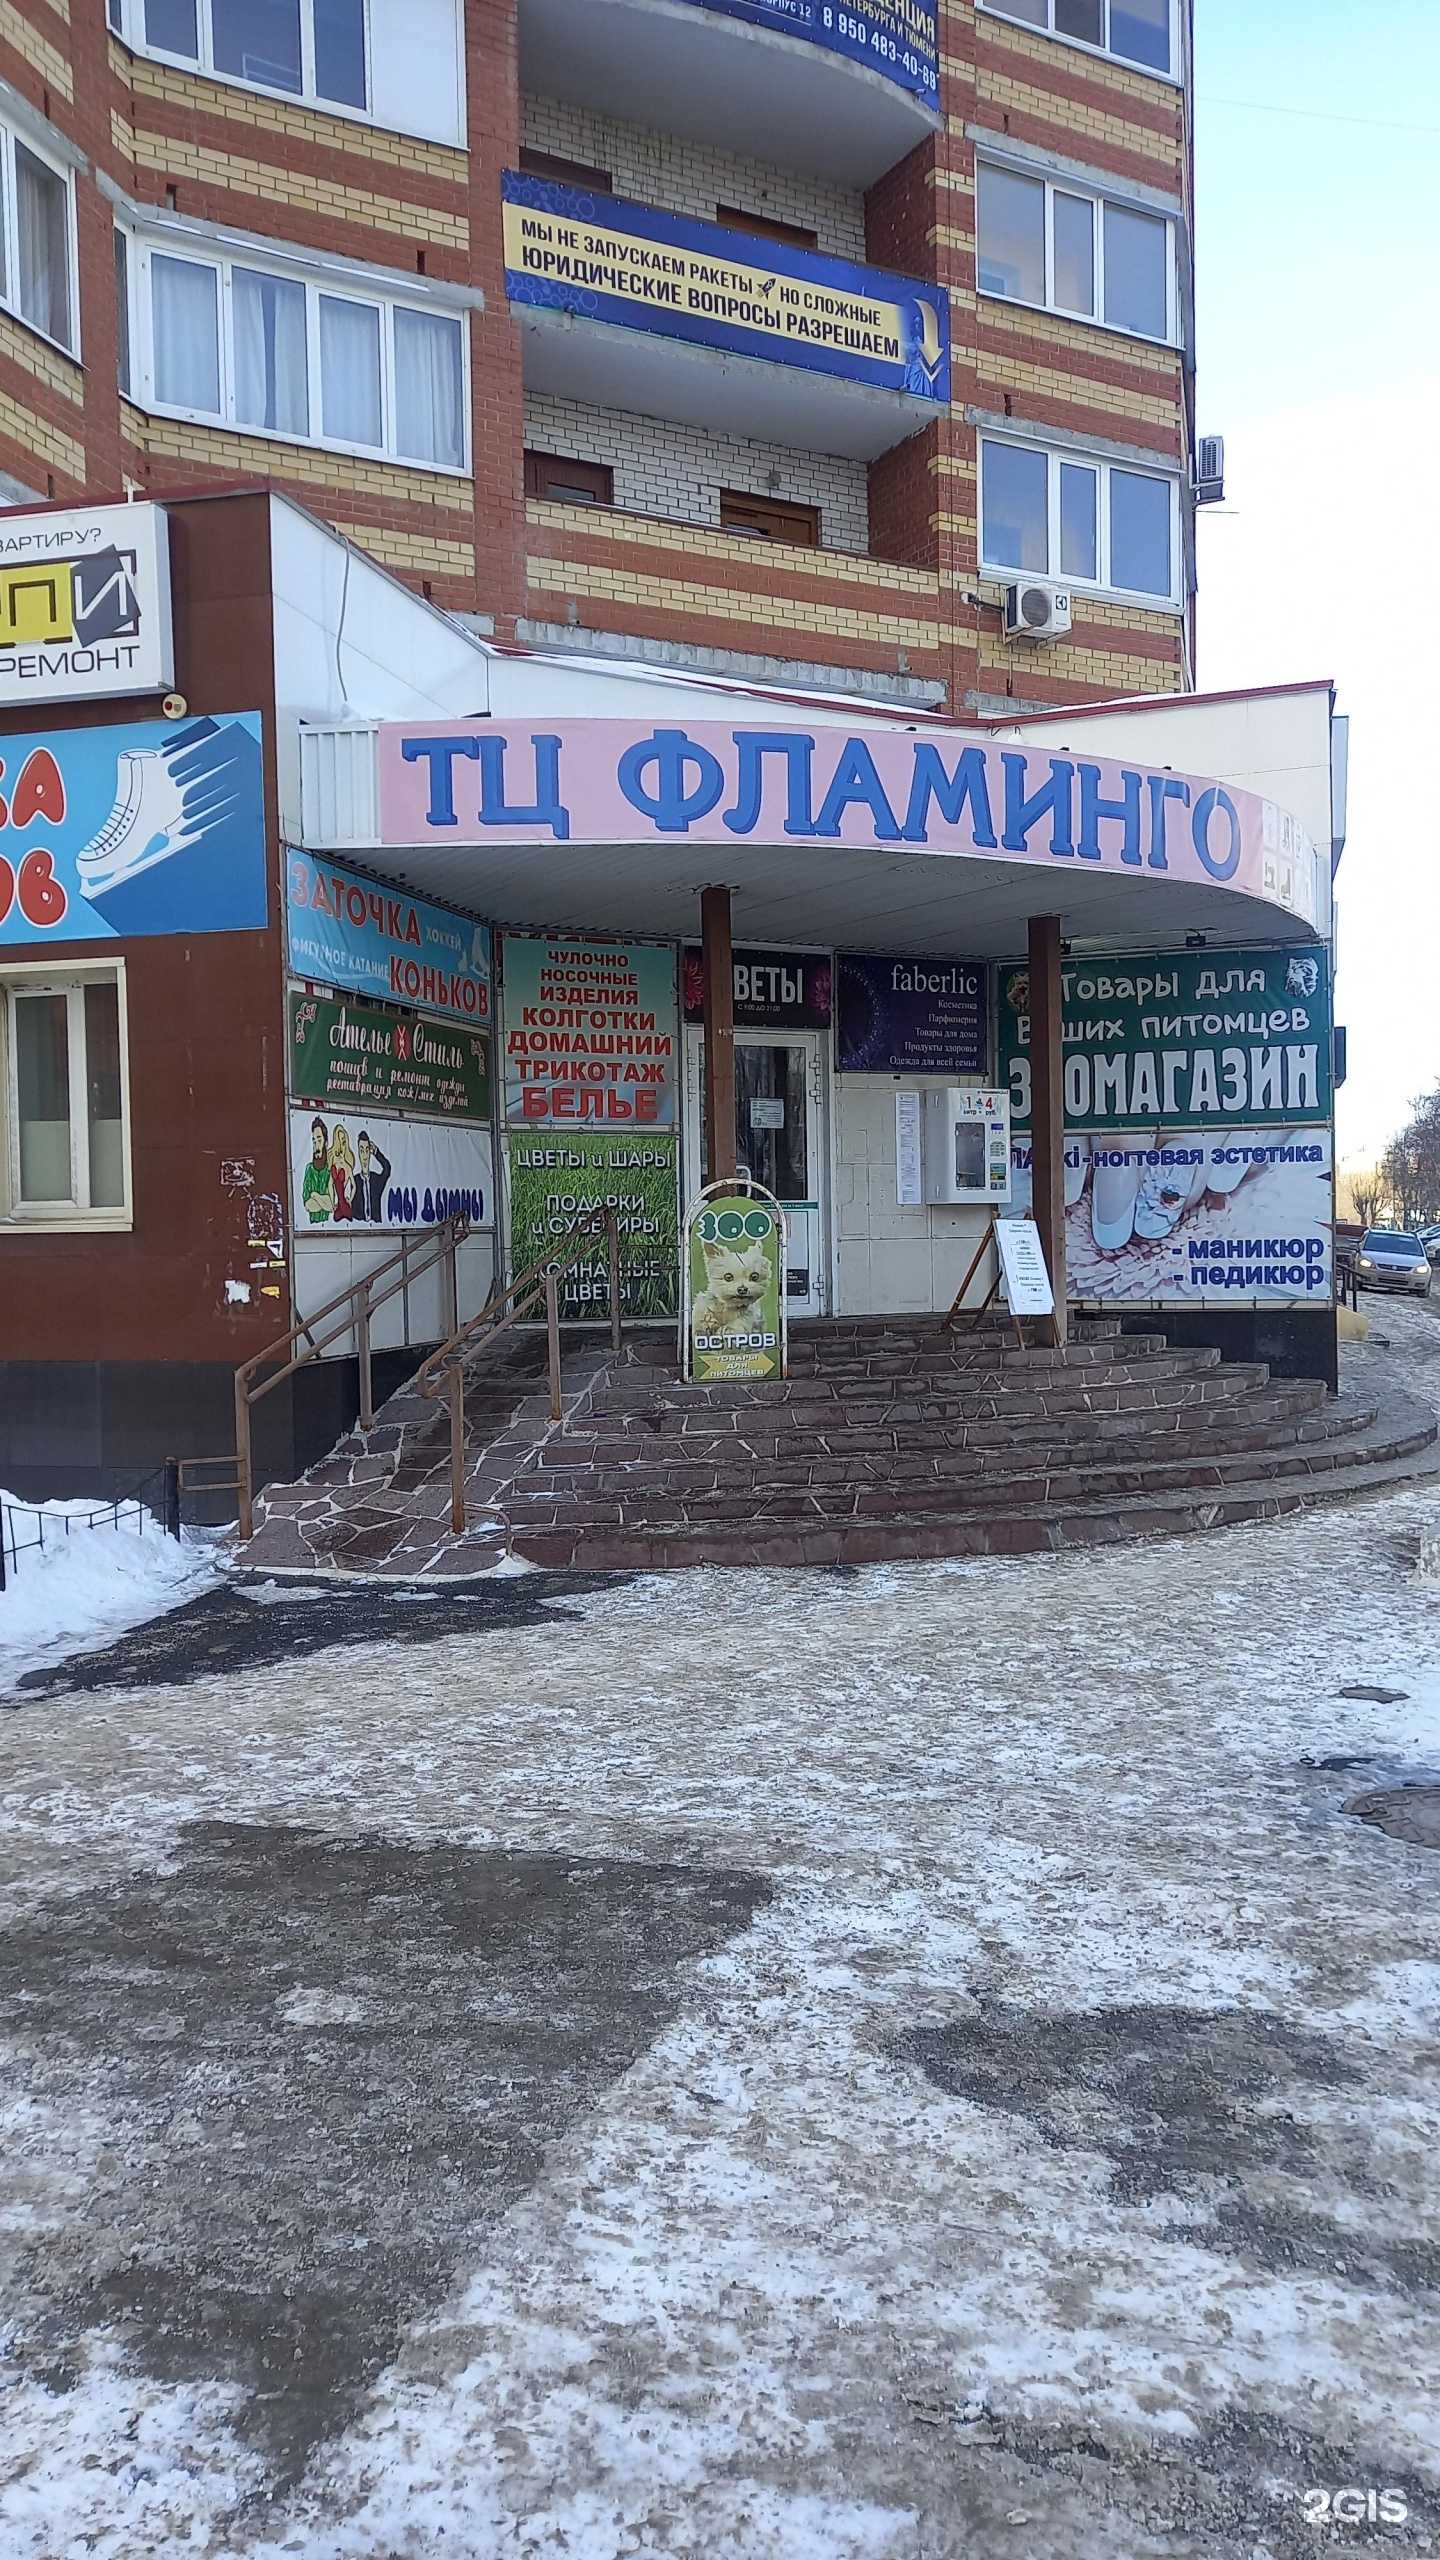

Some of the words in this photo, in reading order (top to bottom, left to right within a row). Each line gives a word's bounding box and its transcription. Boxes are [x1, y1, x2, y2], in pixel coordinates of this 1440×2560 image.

[799, 3, 811, 17] 12
[823, 6, 833, 28] 8
[838, 13, 866, 44] 950
[897, 20, 903, 38] И
[904, 25, 936, 62] ТЮМЕНИ
[521, 218, 553, 243] МЫ
[557, 228, 580, 250] НЕ
[583, 235, 685, 277] ЗАПУСКАЕМ
[689, 262, 753, 294] РАКЕТЫ
[779, 286, 800, 306] НО
[803, 292, 881, 327] СЛОЖНЫЕ
[522, 245, 682, 305] ЮРИДИЧЕСКИЕ
[687, 287, 781, 330] ВОПРОСЫ
[786, 312, 899, 358] РАЗРЕШАЕМ
[0, 527, 102, 552] АРТИРУ?
[400, 734, 570, 839] ТЦ
[617, 728, 1242, 883] ФЛАМИНГО
[289, 861, 423, 949] ЗАТОЧКА
[548, 950, 629, 968] ЧУЛОЧНО
[389, 954, 490, 1018] КОНЬКОВ
[541, 968, 639, 986] НОСОЧНЫЕ
[733, 964, 803, 1004] ВЕТЫ
[890, 963, 978, 995] faberlic
[1061, 970, 1179, 1006] Товары
[1195, 969, 1266, 1000] для
[540, 986, 639, 1006] ИЗДЕЛИЯ
[938, 999, 978, 1010] Косметика
[522, 1006, 656, 1031] КОЛГОТКИ
[928, 1013, 978, 1026] Парфюмерия
[1017, 1016, 1126, 1045] Вших
[1141, 1007, 1311, 1040] питомцев
[329, 1006, 393, 1056] Ателье
[413, 1023, 465, 1070] Стиль
[507, 1031, 672, 1056] ДОМАШНИЙ
[915, 1027, 943, 1039] Товары
[959, 1031, 978, 1039] дома
[904, 1041, 943, 1053] Продукты
[514, 1059, 665, 1083] ТРИКОТАЖ
[889, 1055, 920, 1066] Одежда
[936, 1057, 953, 1066] всей
[954, 1059, 977, 1067] семьи
[326, 1077, 392, 1100] реставрация
[375, 1067, 383, 1080] и
[390, 1069, 431, 1087] ремонт
[1008, 1044, 1320, 1119] ЗОМАГАЗИН
[521, 1086, 658, 1121] БЕЛЬЕ
[516, 1149, 586, 1169] ЦВЕТЫ
[591, 1156, 603, 1167] и
[608, 1151, 671, 1168] ШАРЫ
[1211, 1144, 1324, 1166] эстетика
[387, 1186, 418, 1223] МЫ
[546, 1194, 645, 1213] ПОДАРКИ
[531, 1222, 544, 1234] и
[1187, 1238, 1325, 1264] маникюр
[1190, 1264, 1325, 1290] педикюр
[694, 1332, 776, 1350] ОСТРОВ
[710, 1369, 764, 1377] ПИТОМЦЕВ
